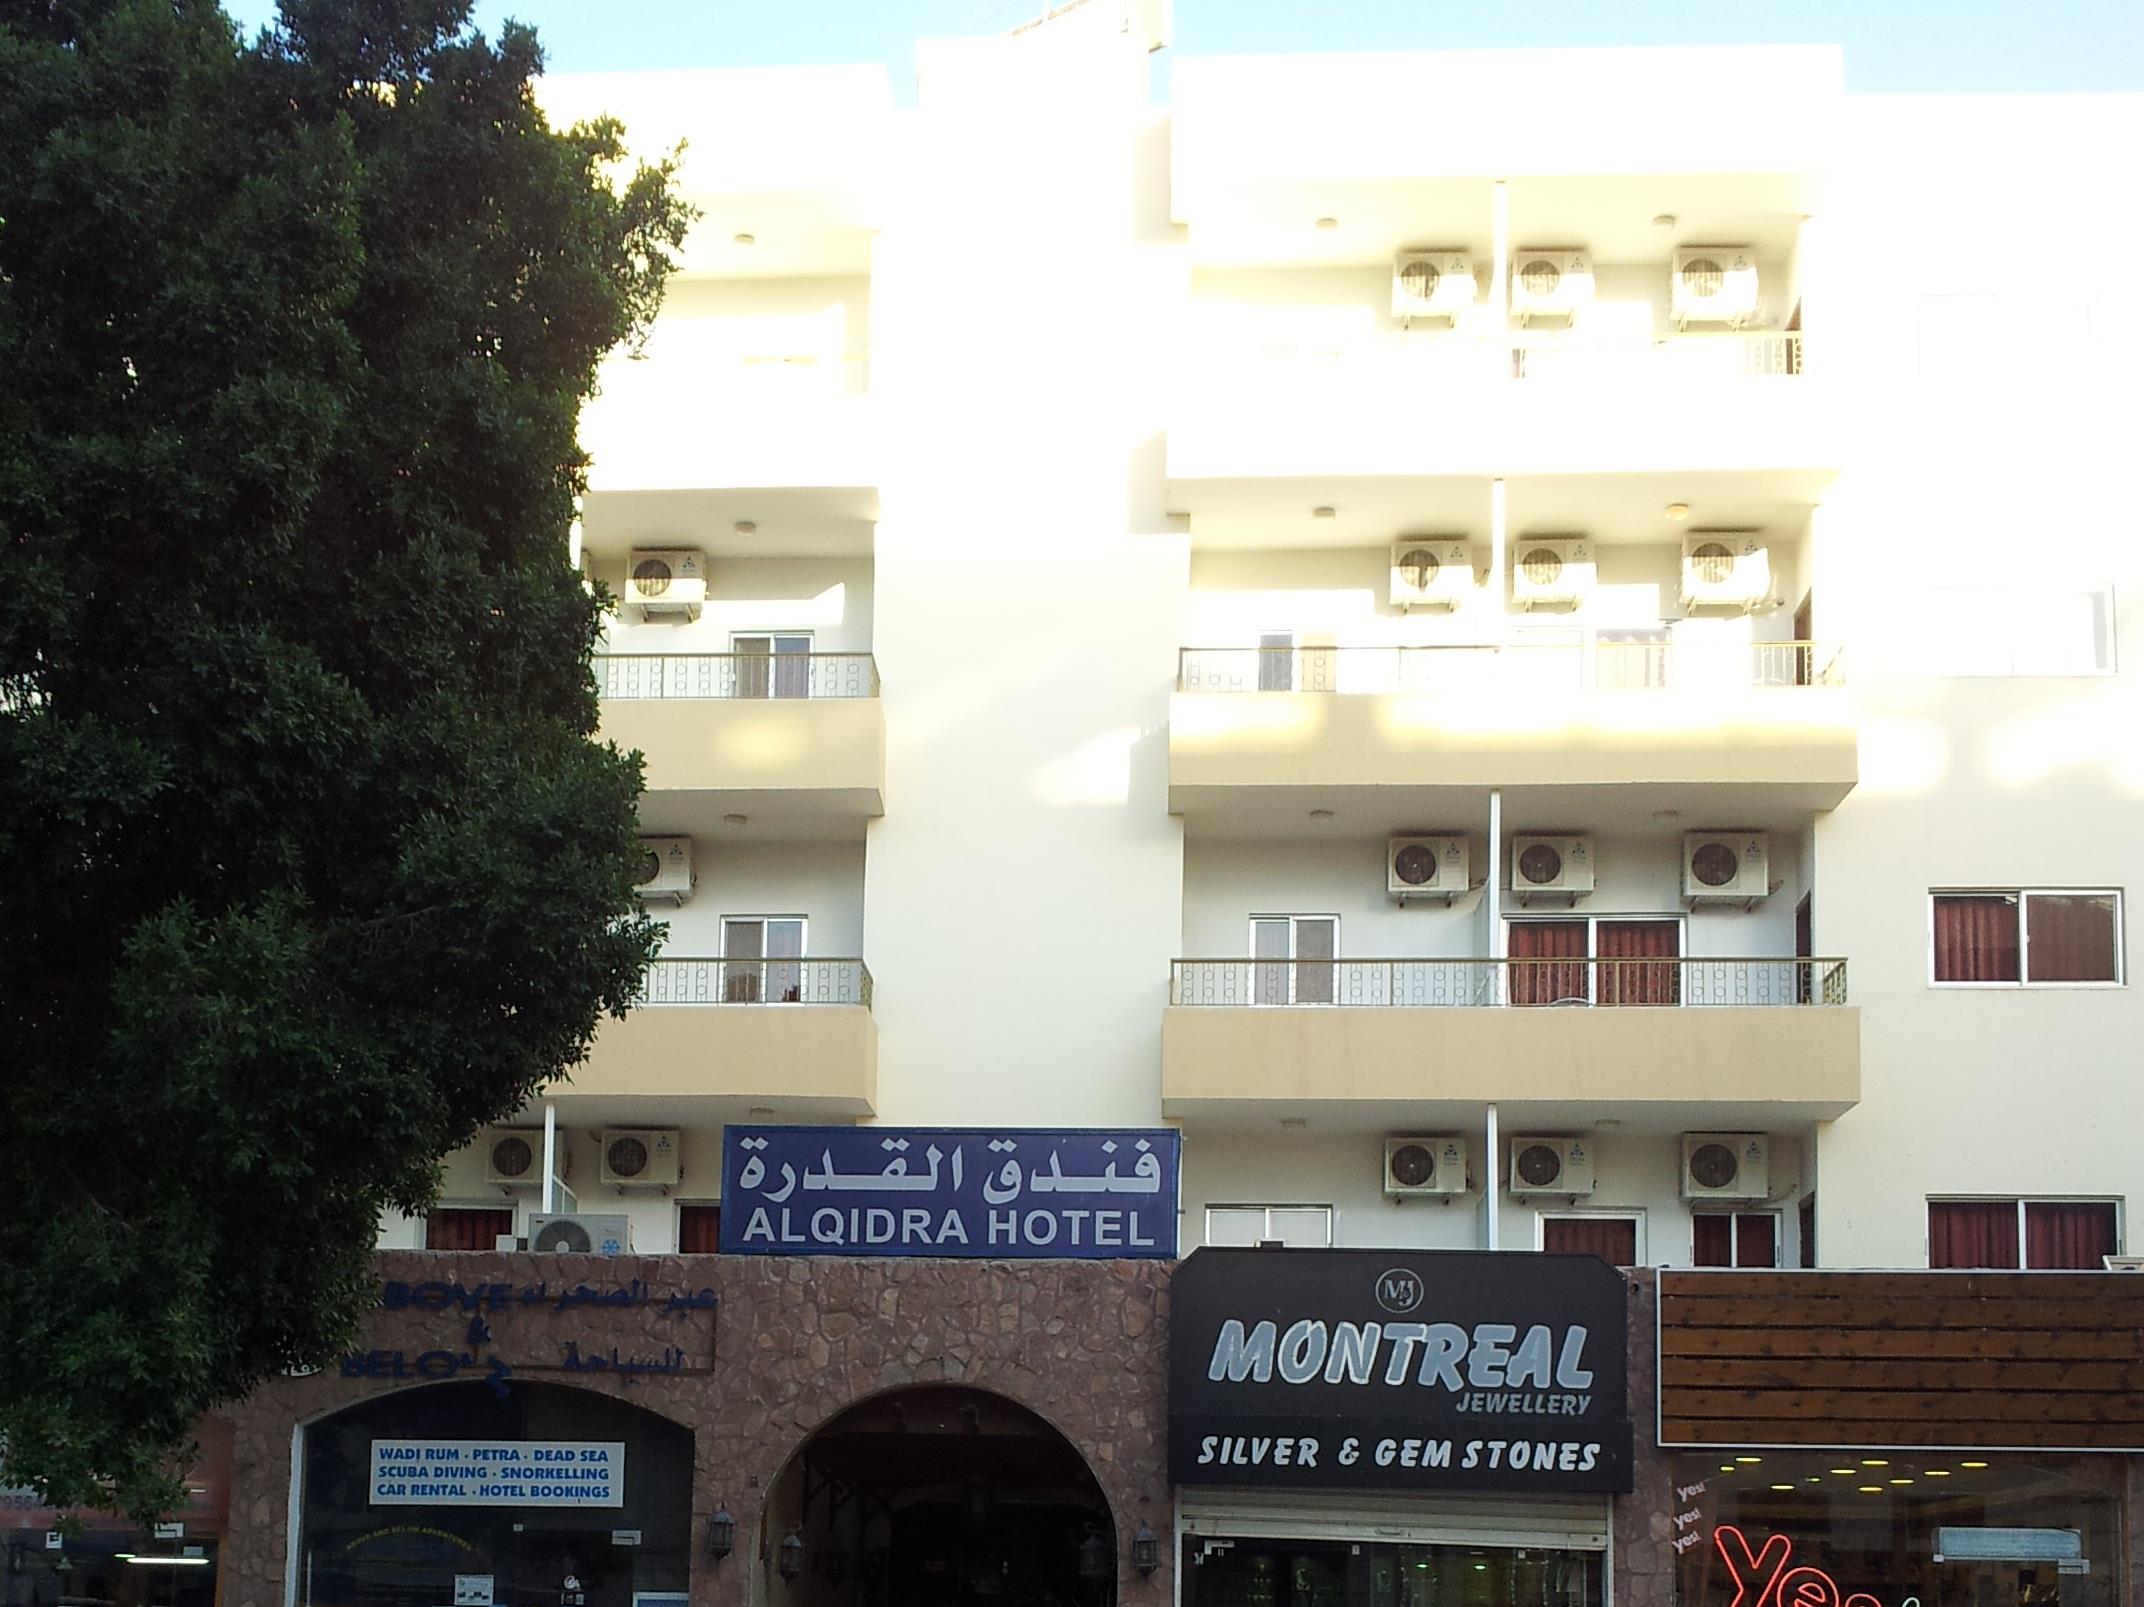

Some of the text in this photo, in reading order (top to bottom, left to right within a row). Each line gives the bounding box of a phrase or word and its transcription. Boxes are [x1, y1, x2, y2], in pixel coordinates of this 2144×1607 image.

[739, 1137, 1161, 1204] فندق القدرة
[742, 1208, 1155, 1246] ALQIDRA HOTEL
[385, 1281, 513, 1311] BOVE
[1208, 1319, 1594, 1392] MONTREAL
[1456, 1392, 1592, 1416] JEWELLERY
[379, 1448, 608, 1462] WADI RUM PETRA DEAD SEA
[1198, 1436, 1601, 1472] SILVER & GEM STONES
[378, 1466, 609, 1480] SCUBA DIVING SNORKELLING
[377, 1484, 610, 1498] CAR RENTAL HOTEL BOOKINGS
[1714, 1526, 1882, 1607] Ye
